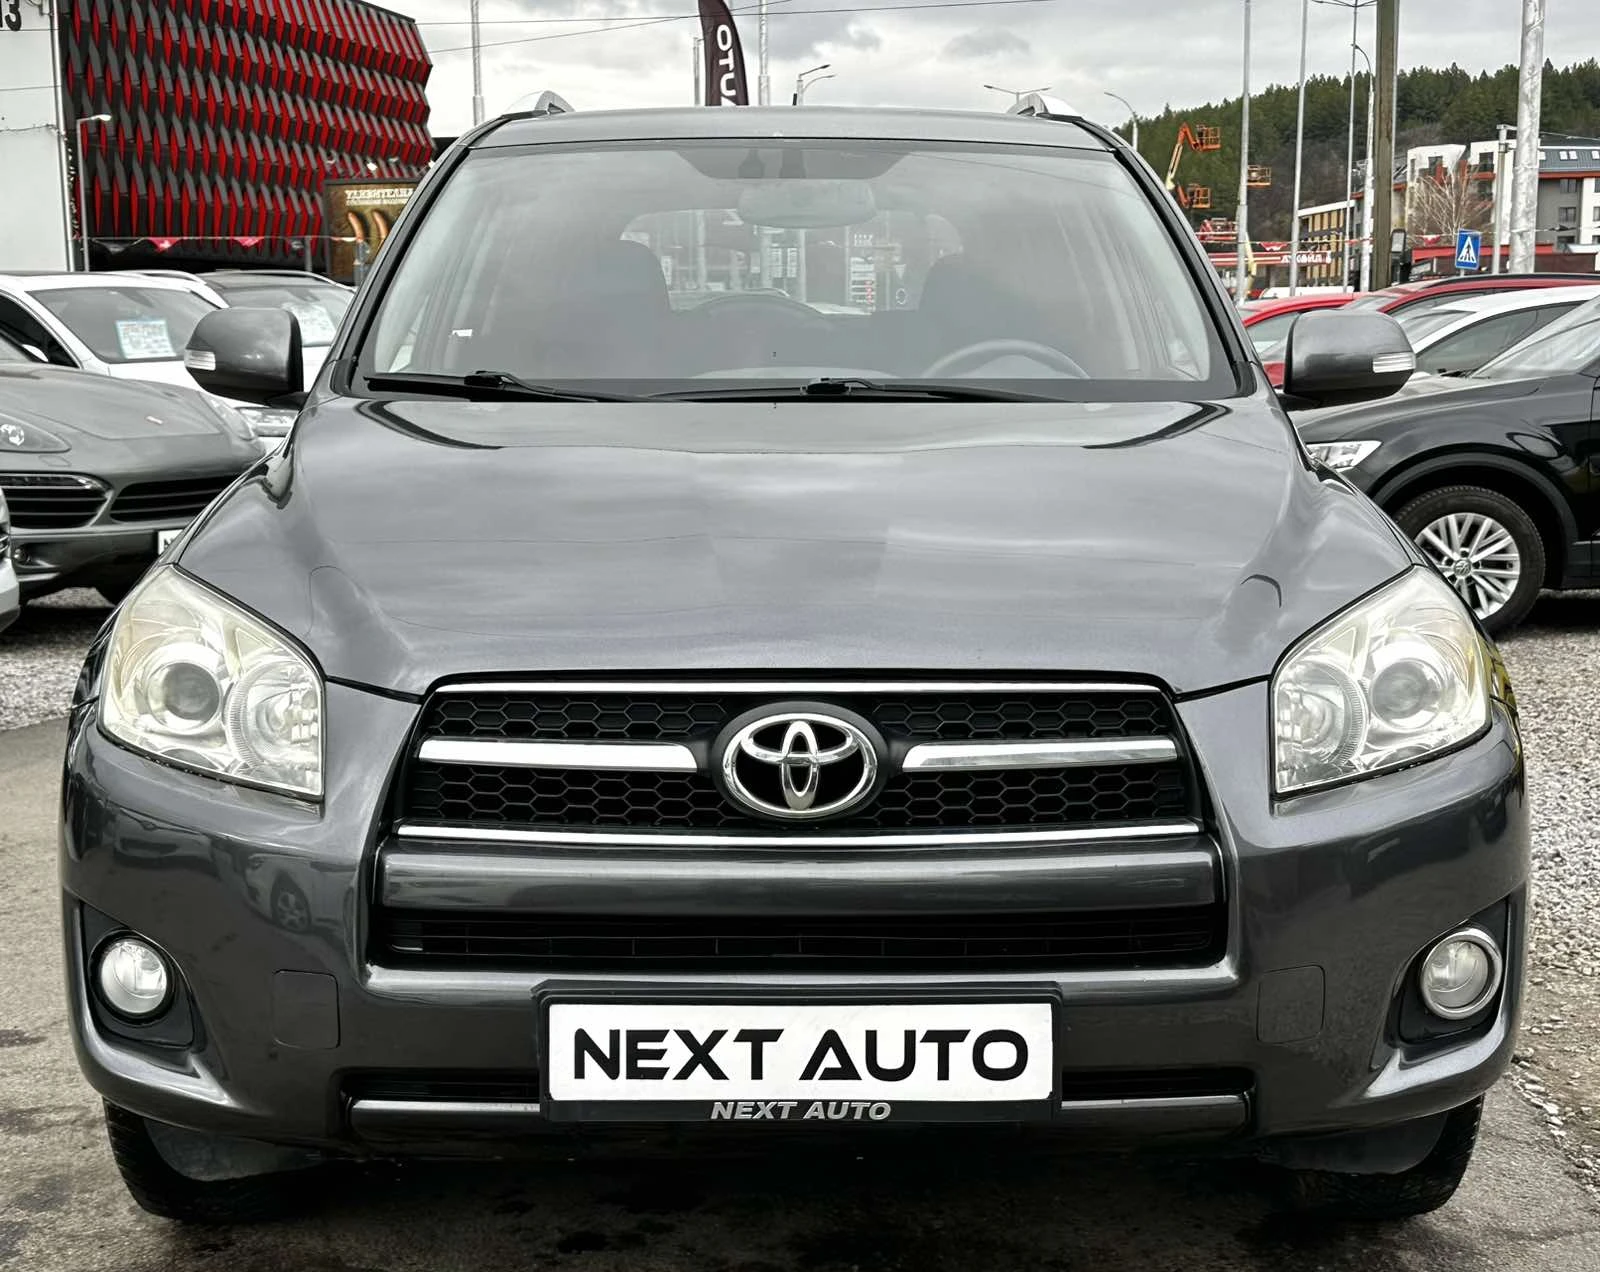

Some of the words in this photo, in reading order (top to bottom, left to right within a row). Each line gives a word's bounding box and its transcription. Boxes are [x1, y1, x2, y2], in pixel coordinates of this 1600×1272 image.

[574, 1028, 784, 1080] NEXT
[798, 1029, 1029, 1082] AUTO
[710, 1101, 798, 1120] NEXT
[802, 1101, 891, 1120] AUTO
